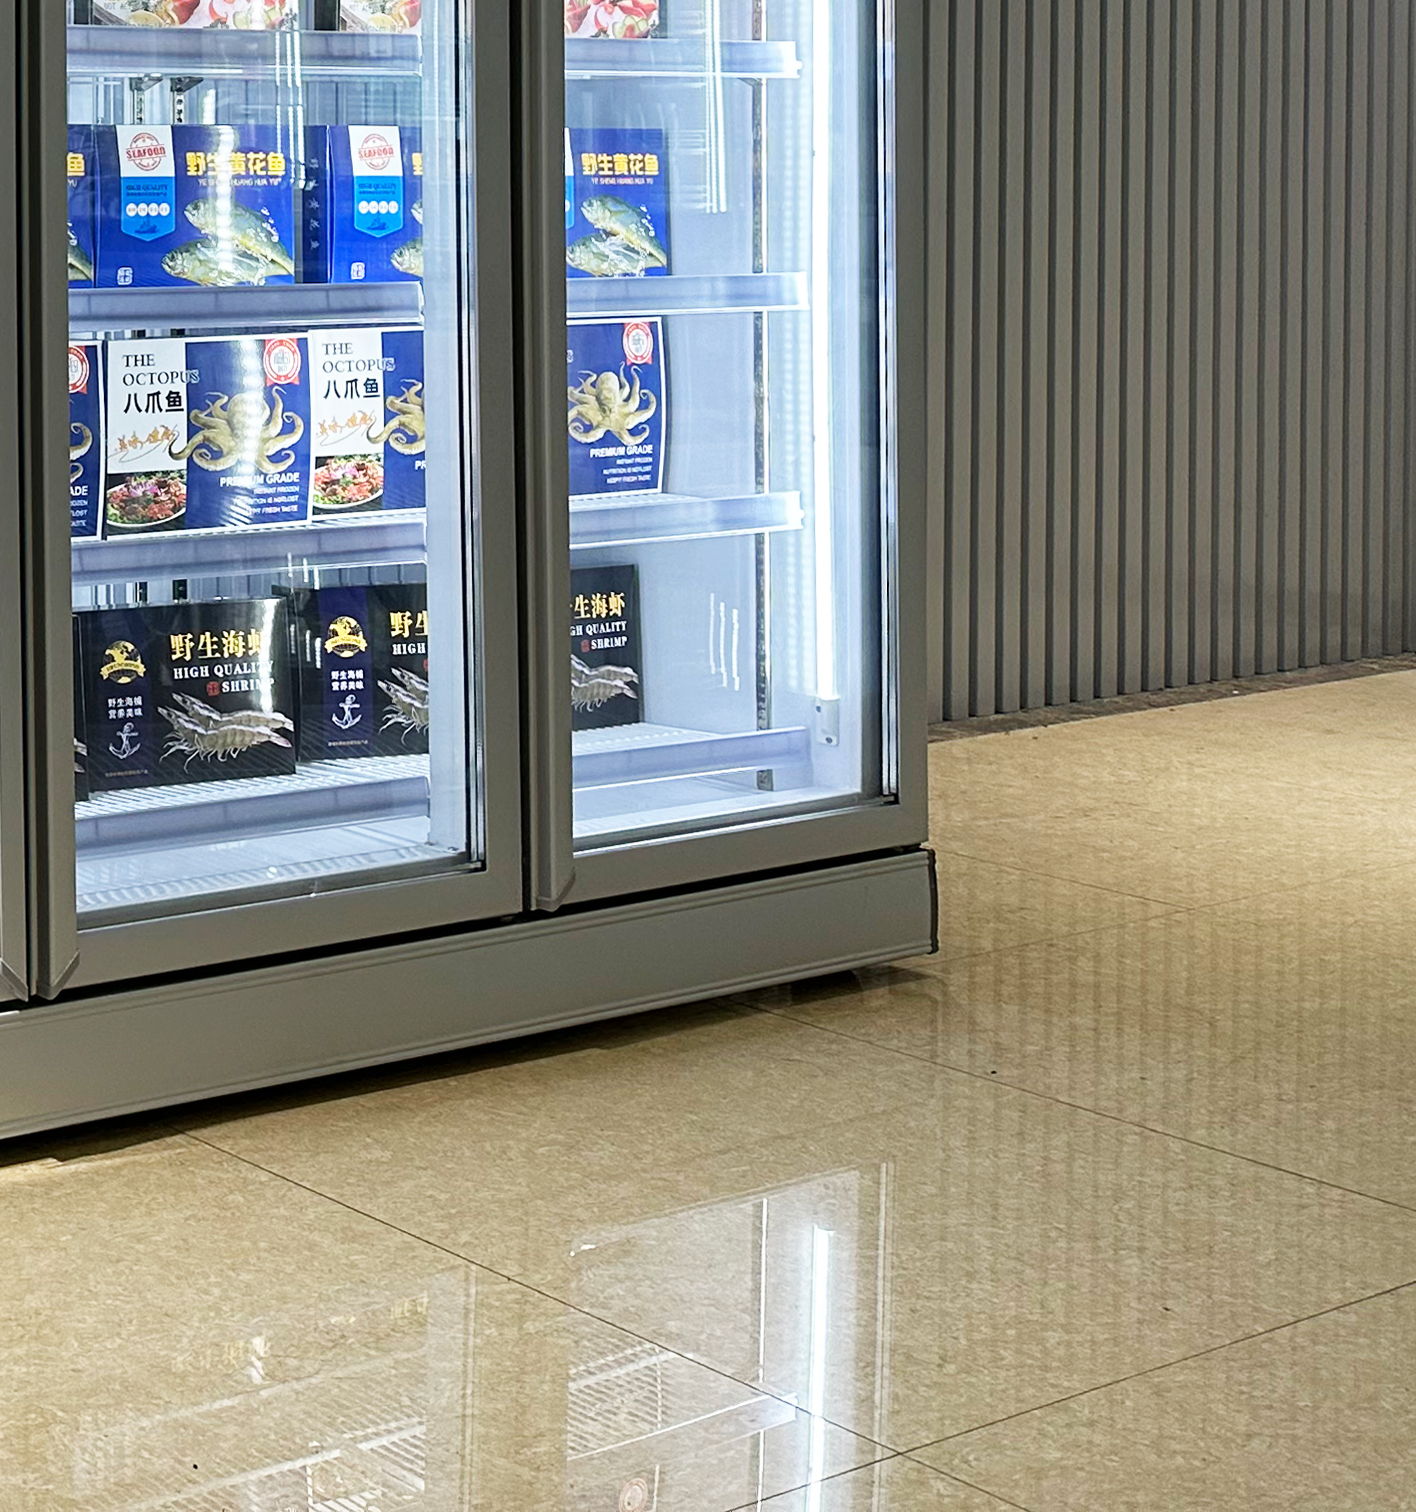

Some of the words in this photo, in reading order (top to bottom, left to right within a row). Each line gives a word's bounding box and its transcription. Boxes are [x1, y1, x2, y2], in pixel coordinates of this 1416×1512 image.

[581, 153, 659, 176] 野生黄花鱼
[322, 343, 353, 356] THE
[122, 354, 155, 368] THE
[322, 358, 396, 373] OCTOPUS
[122, 369, 200, 386] OCTOPUS
[323, 377, 380, 399] 八爪鱼
[123, 390, 184, 414] 八爪鱼
[590, 446, 625, 458] PREMIUM
[627, 444, 653, 455] GRADE
[266, 473, 300, 484] GRADE
[586, 620, 627, 636] QUALITY
[392, 642, 426, 655] HIGH
[591, 636, 628, 649] SHRIMP
[173, 666, 210, 679] HIGH
[214, 660, 274, 677] QUALIY
